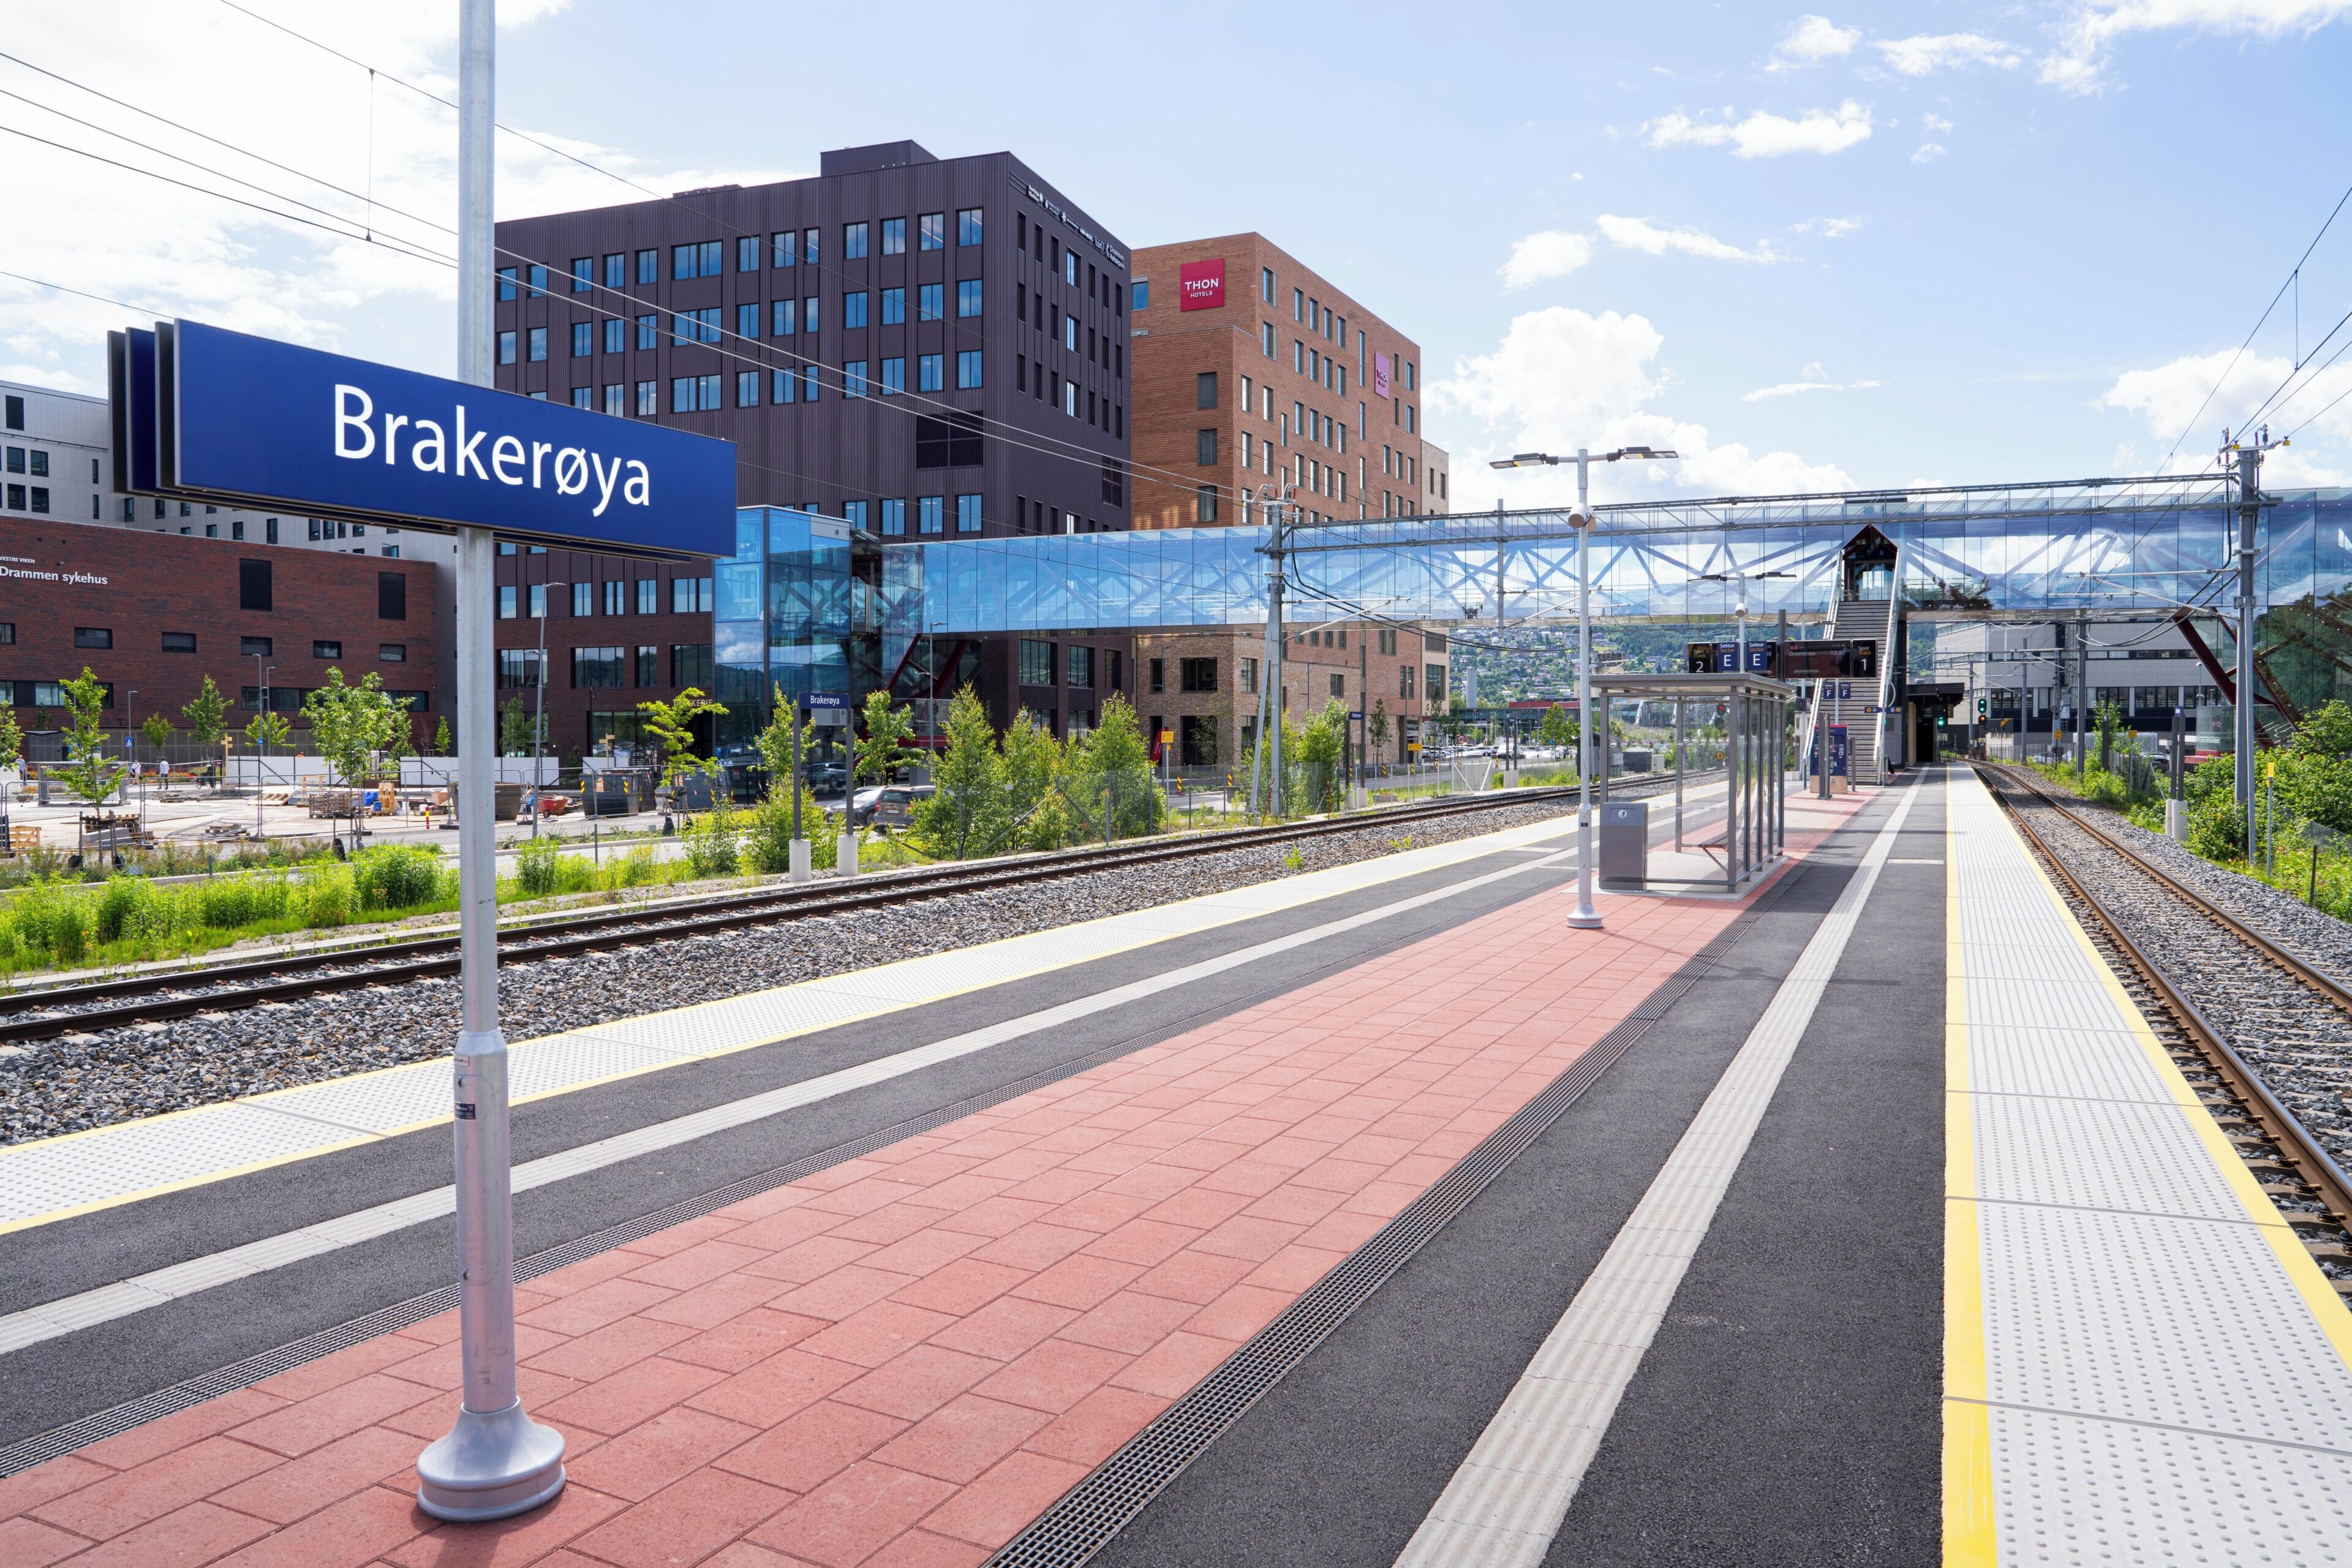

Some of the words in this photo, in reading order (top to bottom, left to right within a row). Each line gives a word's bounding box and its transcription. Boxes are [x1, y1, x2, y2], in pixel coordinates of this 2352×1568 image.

[1185, 277, 1219, 291] THON
[1376, 369, 1389, 383] THON
[334, 383, 650, 517] Brakerøya
[0, 566, 58, 581] Drammen
[62, 571, 108, 585] sykehus
[1724, 654, 1732, 667] E
[1753, 654, 1761, 666] E
[1861, 658, 1867, 671] 1
[1695, 661, 1704, 673] 2
[810, 695, 840, 707] Brakerøya
